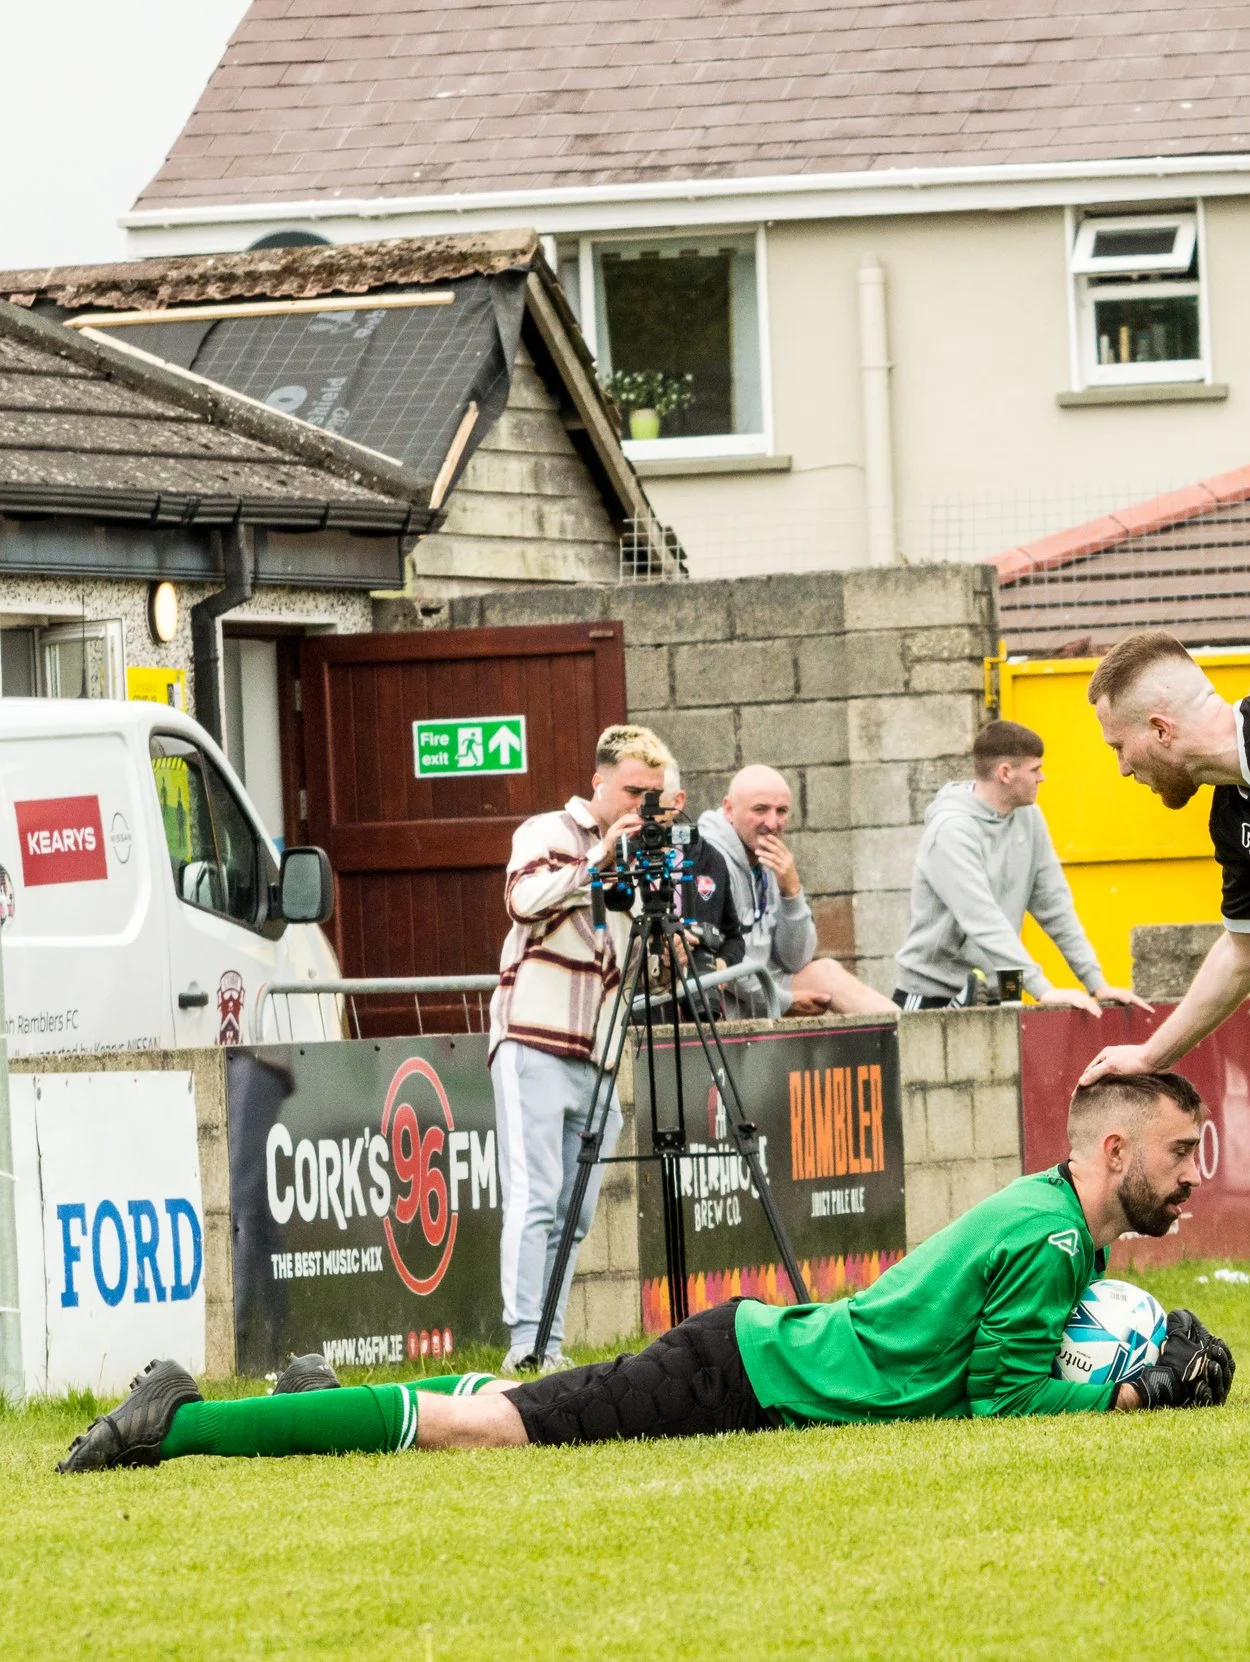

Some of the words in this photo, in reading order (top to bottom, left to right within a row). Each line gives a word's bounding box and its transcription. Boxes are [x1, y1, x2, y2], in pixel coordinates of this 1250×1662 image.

[420, 732, 449, 746] Fire
[422, 751, 449, 766] exit
[27, 826, 96, 855] KEARYS
[18, 1011, 63, 1034] Ramblers
[66, 1009, 79, 1030] FC
[789, 1064, 884, 1181] RAMBLER
[392, 1103, 448, 1246] 96
[449, 1130, 498, 1210] FM
[694, 1198, 723, 1231] BREW
[57, 1198, 203, 1308] FORD
[271, 1252, 294, 1279] THE
[294, 1250, 322, 1277] BEST
[323, 1248, 360, 1275] MUSIC
[362, 1246, 383, 1272] MIX
